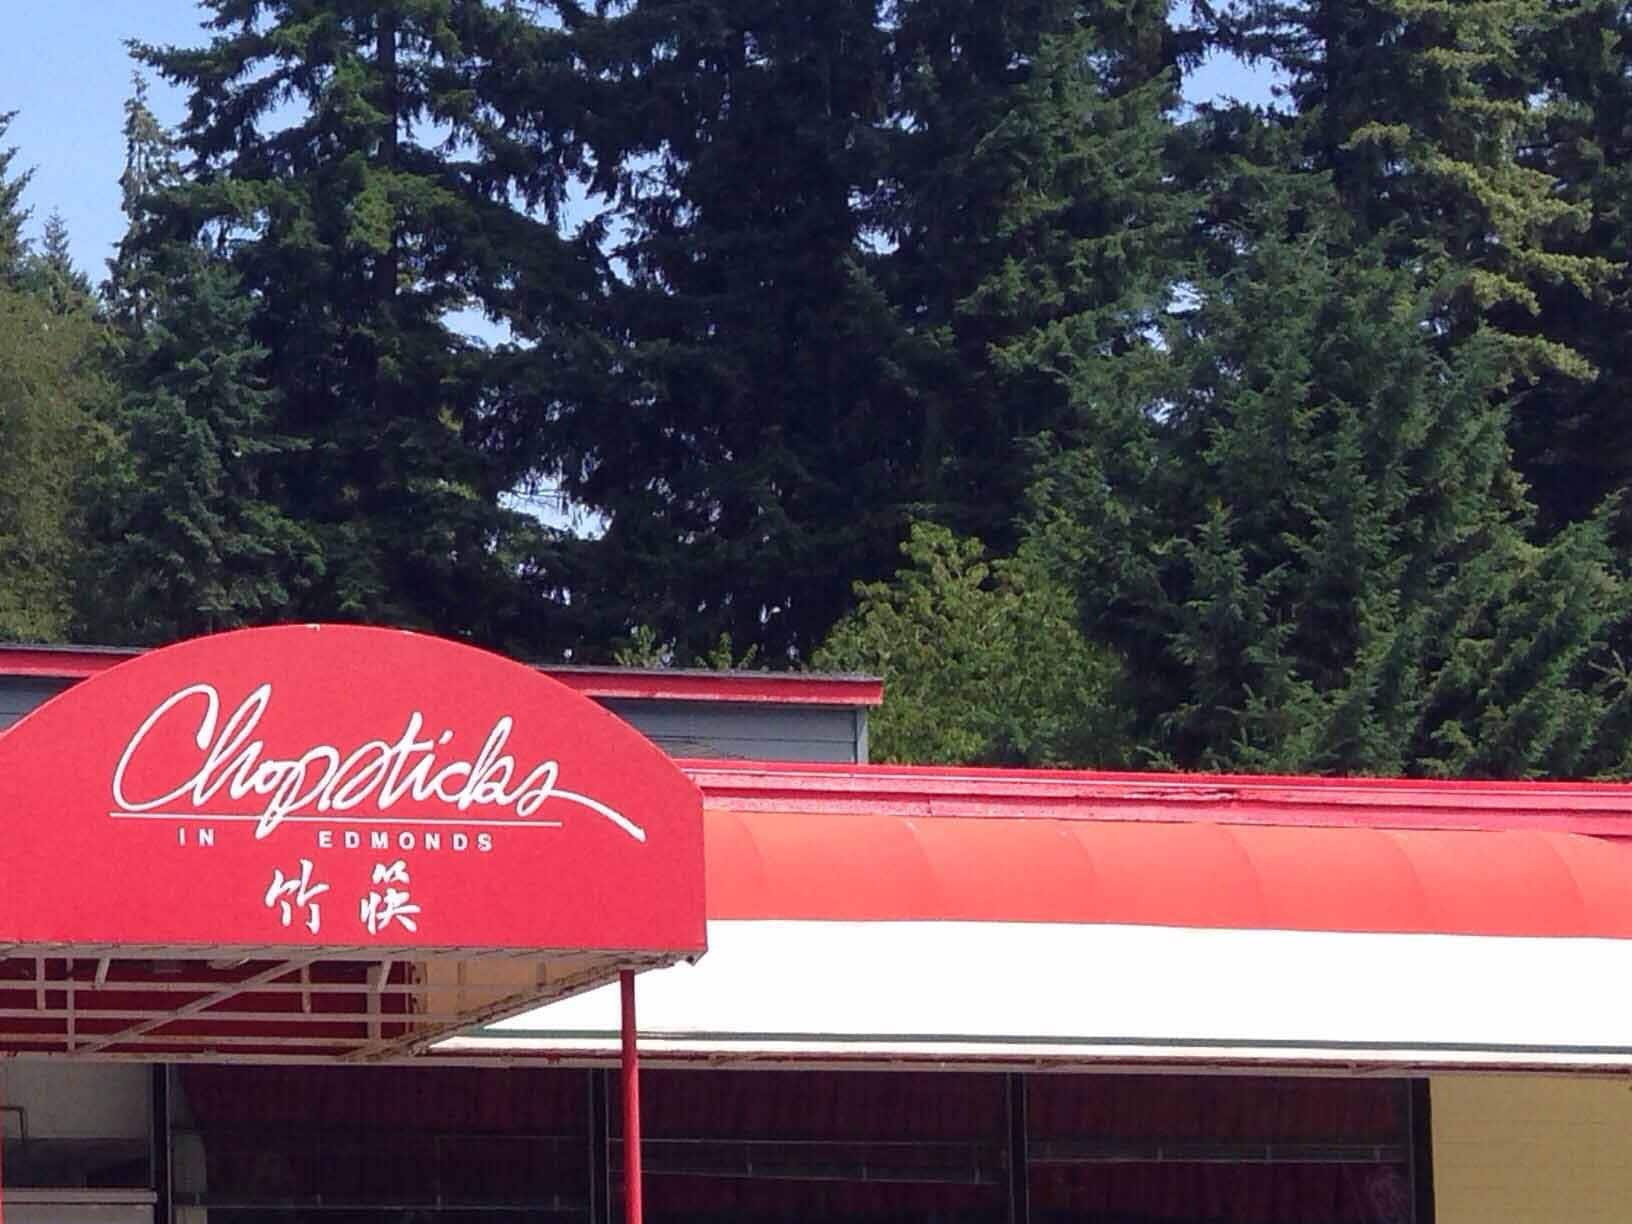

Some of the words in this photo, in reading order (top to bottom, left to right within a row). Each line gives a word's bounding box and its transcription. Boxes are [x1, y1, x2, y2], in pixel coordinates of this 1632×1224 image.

[111, 683, 646, 843] Chopsticks
[179, 828, 214, 846] IN
[318, 830, 493, 852] EDMONDS
